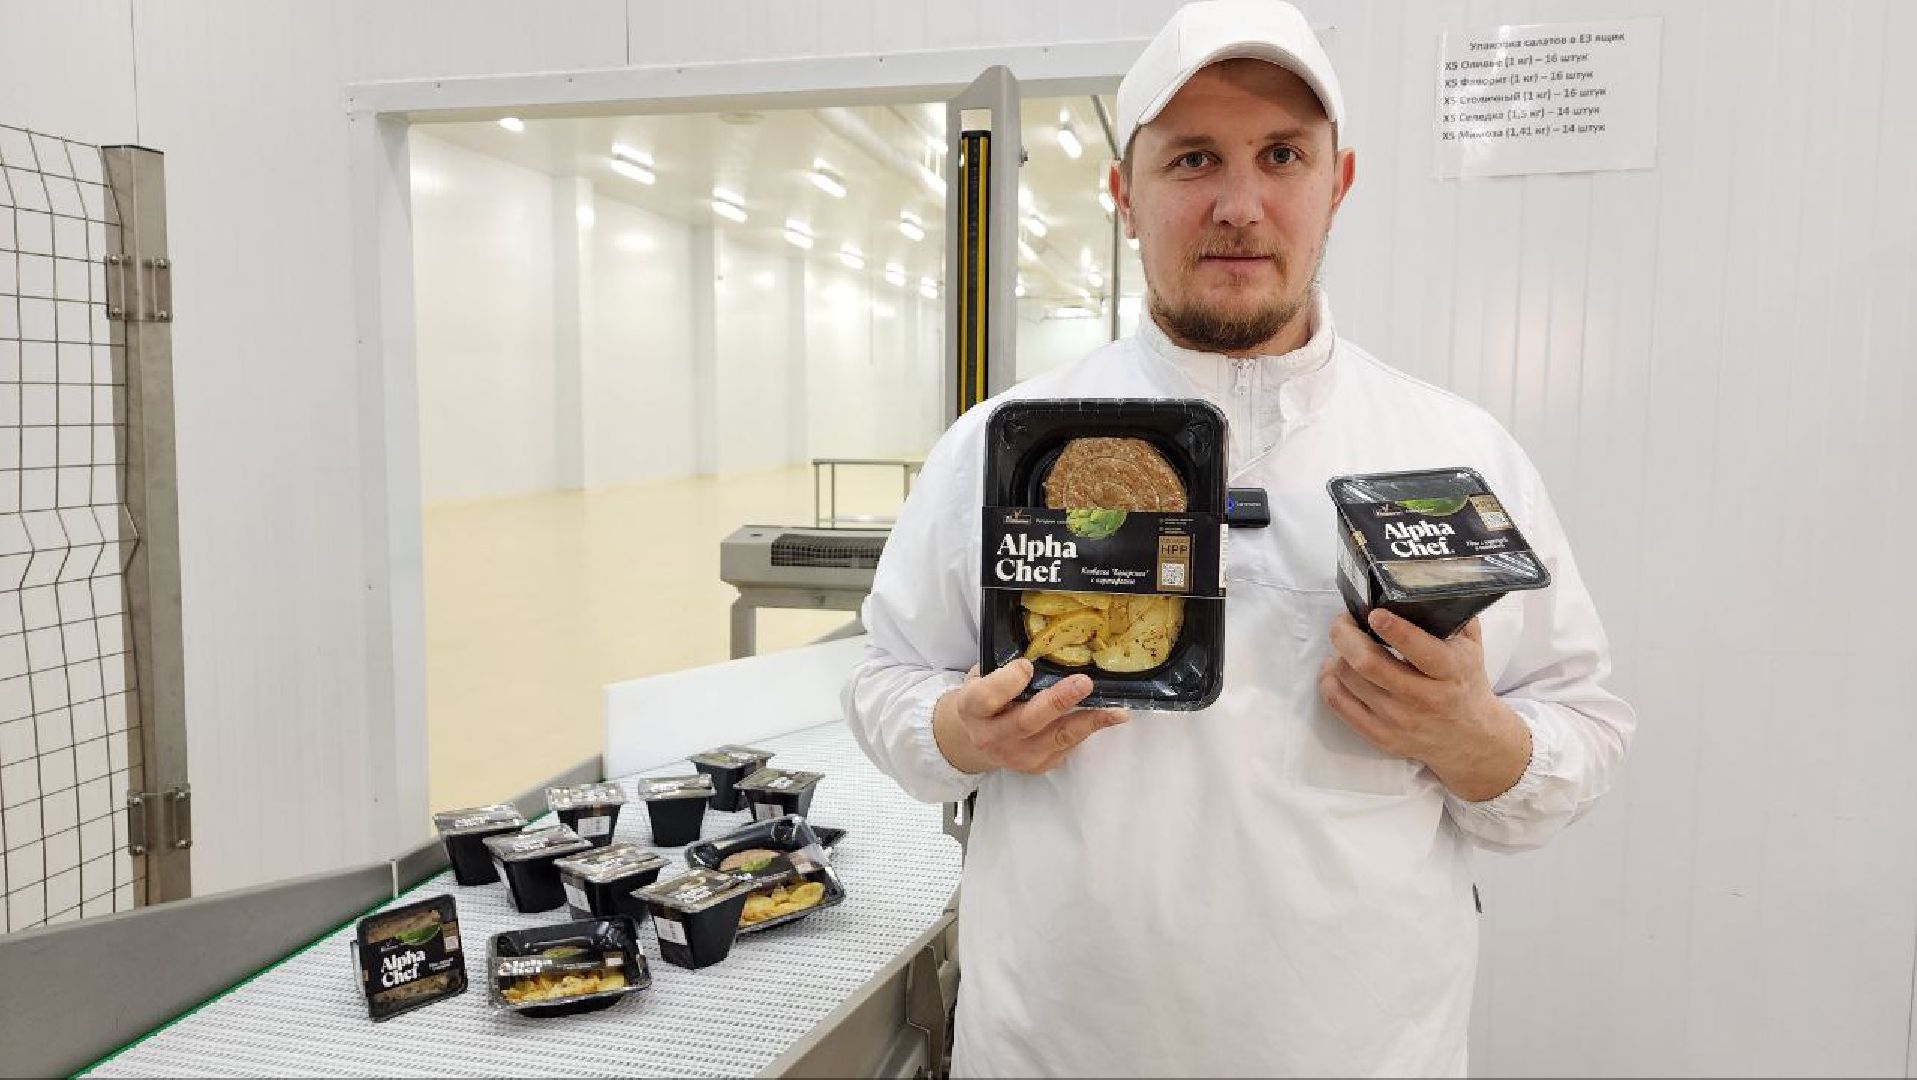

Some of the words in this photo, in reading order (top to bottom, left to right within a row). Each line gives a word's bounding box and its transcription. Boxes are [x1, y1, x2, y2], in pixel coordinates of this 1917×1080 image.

[1524, 37, 1566, 47] салатов
[1570, 36, 1576, 44] в
[1595, 33, 1625, 43] ящик
[1505, 55, 1515, 68] (1
[1517, 54, 1532, 67] кг)
[1545, 53, 1558, 63] 16
[1560, 54, 1588, 63] штук
[1511, 73, 1520, 85] (1
[1523, 73, 1538, 83] кг)
[1551, 71, 1563, 80] 16
[1566, 72, 1594, 81] штук
[1524, 91, 1533, 102] (1
[1536, 88, 1551, 100] кг)
[1564, 88, 1577, 97] 16
[1580, 88, 1606, 98] штук
[1530, 107, 1544, 119] кг)
[1557, 106, 1569, 115] 14
[1573, 106, 1600, 116] штук
[1535, 124, 1550, 136] кг)
[1562, 124, 1575, 133] 14
[1578, 124, 1606, 134] штук
[1385, 520, 1456, 542] Alpha
[996, 533, 1078, 561] Alpha
[1161, 544, 1188, 555] HPP
[381, 950, 426, 973] Alpha
